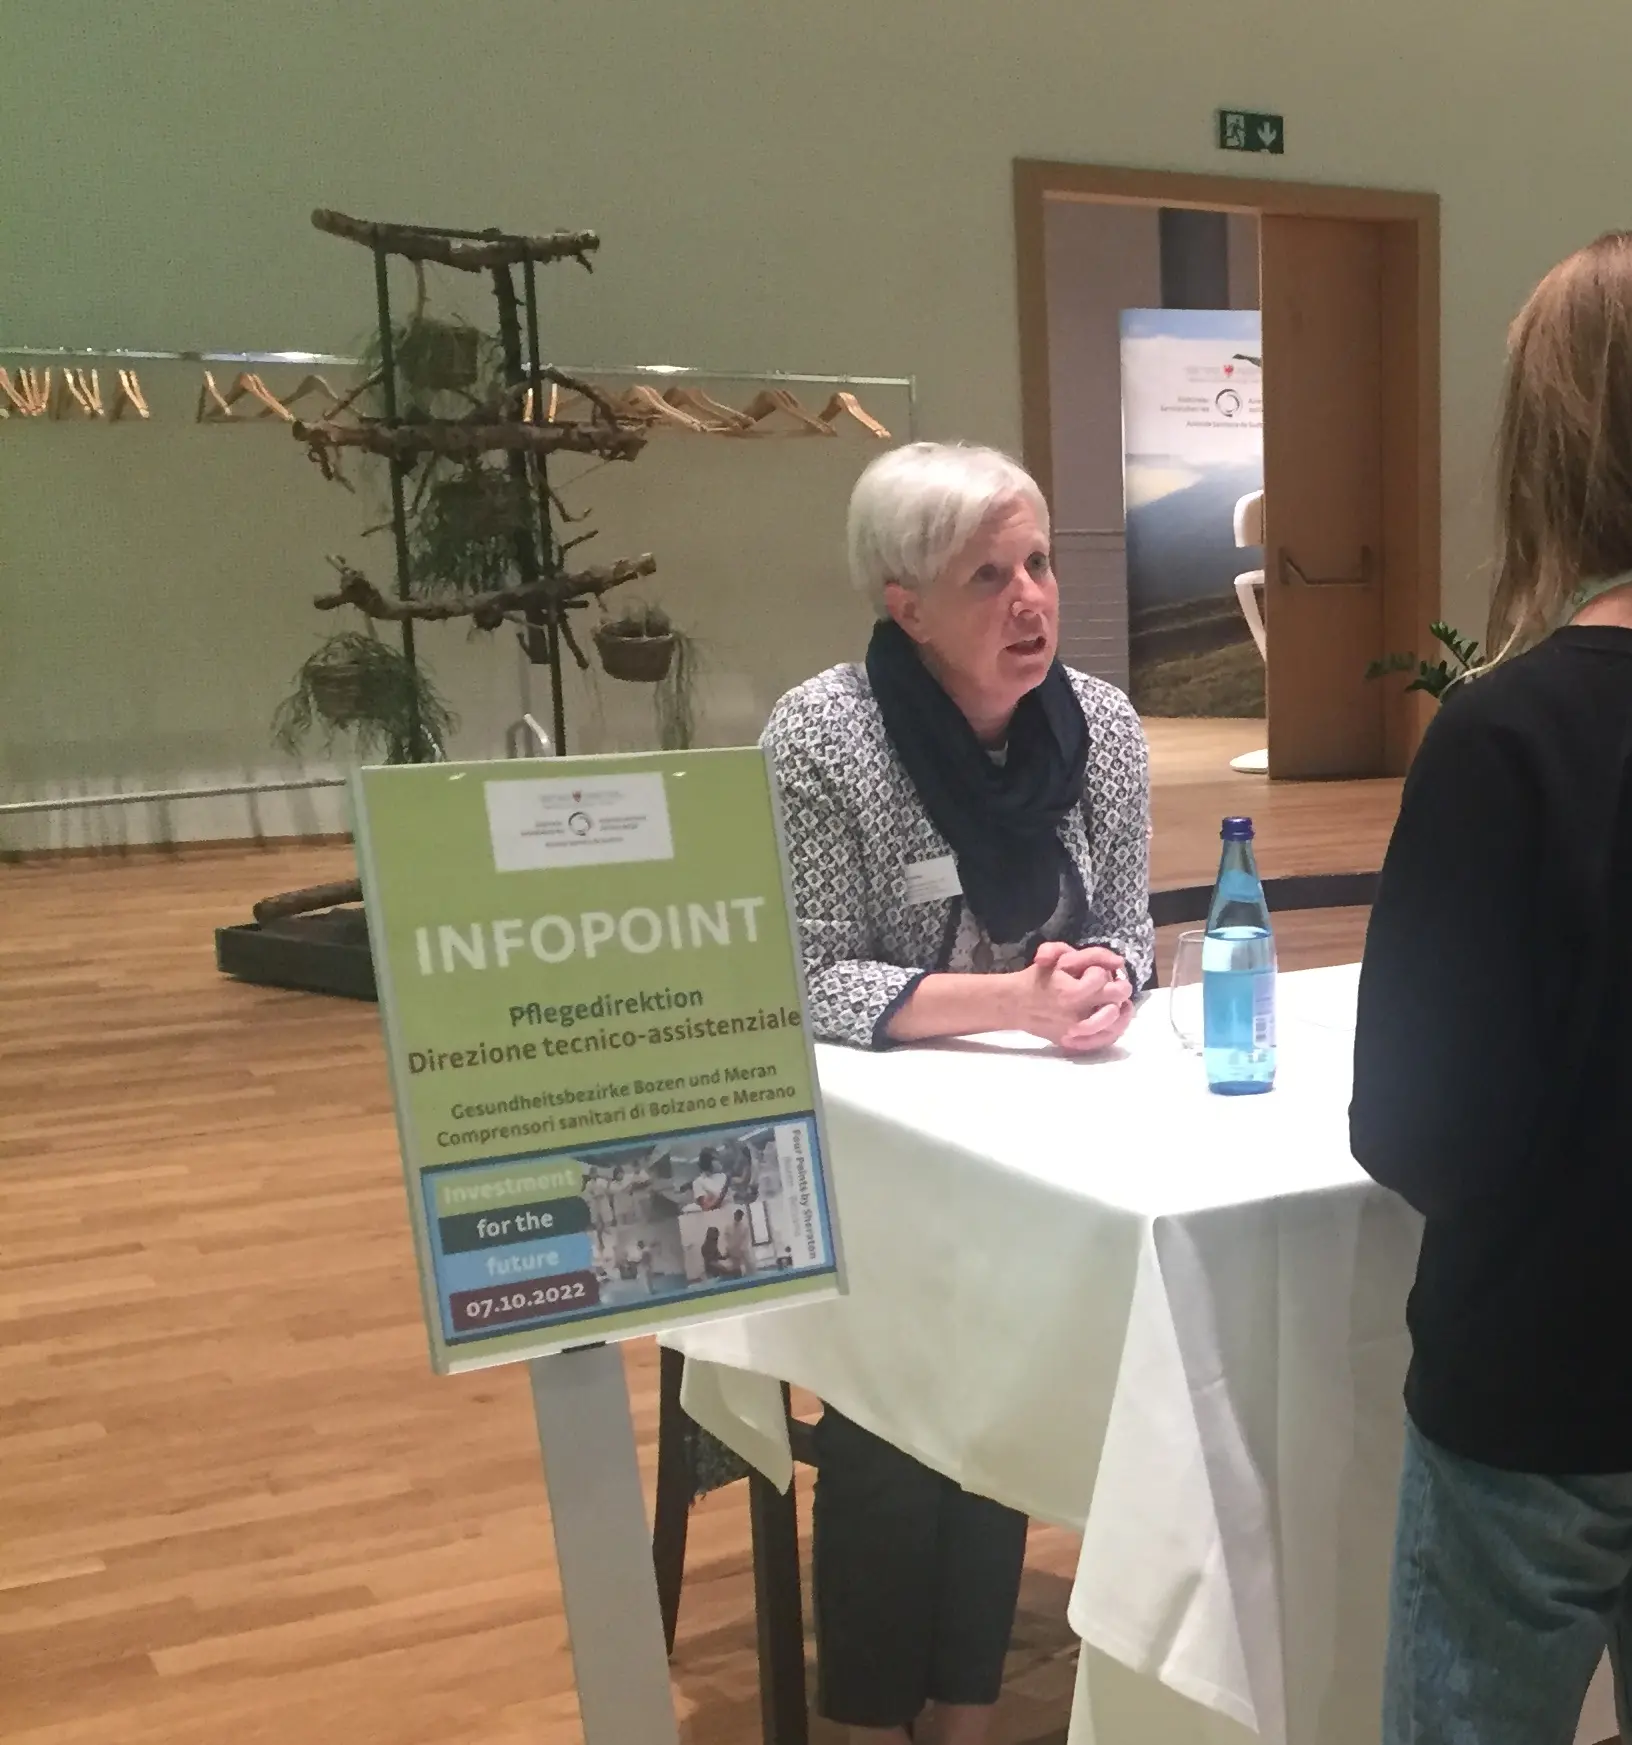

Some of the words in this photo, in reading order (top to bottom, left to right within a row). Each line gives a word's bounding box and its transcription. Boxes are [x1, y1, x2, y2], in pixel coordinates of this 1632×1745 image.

[415, 896, 766, 976] INFOPOINT
[508, 986, 704, 1028] Pflegedirektion
[408, 1041, 537, 1074] Direzione
[542, 1006, 801, 1057] tecnico-assistenziale
[451, 1082, 630, 1121] Gesundheitsbezirke
[634, 1076, 686, 1095] Bozen
[689, 1068, 721, 1088] und
[725, 1063, 778, 1084] Meran
[436, 1114, 555, 1148] Comprensori
[558, 1106, 626, 1131] sanitari
[629, 1103, 646, 1120] di
[650, 1095, 717, 1118] Bolzano
[720, 1094, 730, 1107] e
[733, 1084, 797, 1105] Merano
[443, 1168, 577, 1205] Investment
[476, 1217, 512, 1240] for
[514, 1210, 554, 1233] the
[485, 1250, 560, 1277] future
[466, 1282, 586, 1320] 07.10.2022
